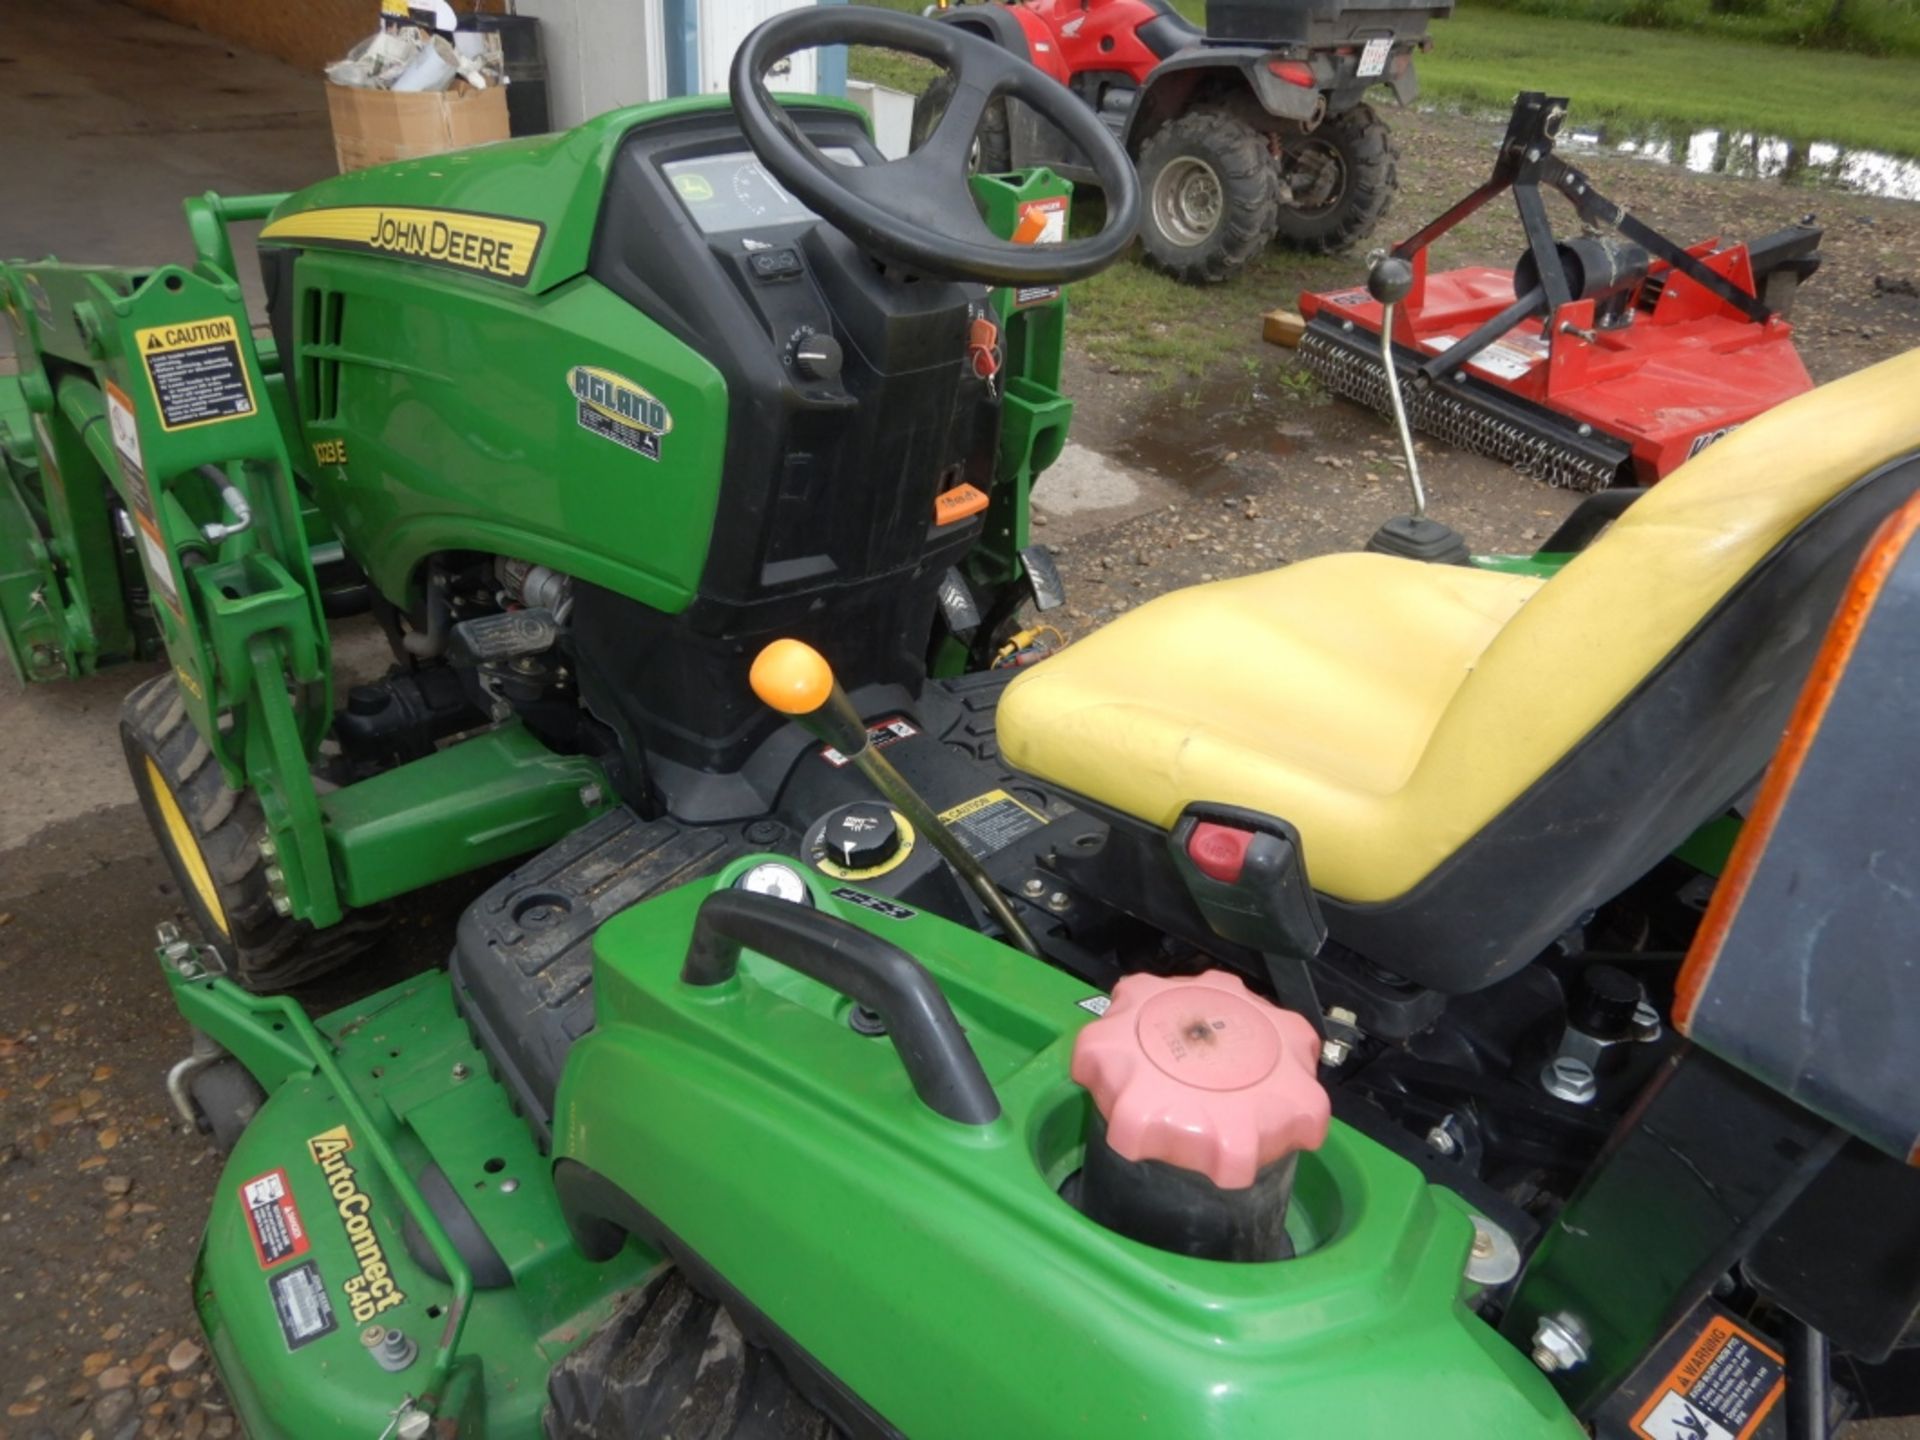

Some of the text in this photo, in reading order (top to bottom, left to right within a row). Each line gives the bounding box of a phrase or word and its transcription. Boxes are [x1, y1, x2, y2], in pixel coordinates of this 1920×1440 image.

[371, 212, 513, 271] JOHN DEERE
[166, 321, 231, 345] CAUTION
[575, 368, 664, 431] AGLAND
[313, 1139, 405, 1313] AutoConnect
[344, 1275, 376, 1322] 54D
[1684, 1328, 1726, 1377] WARNING
